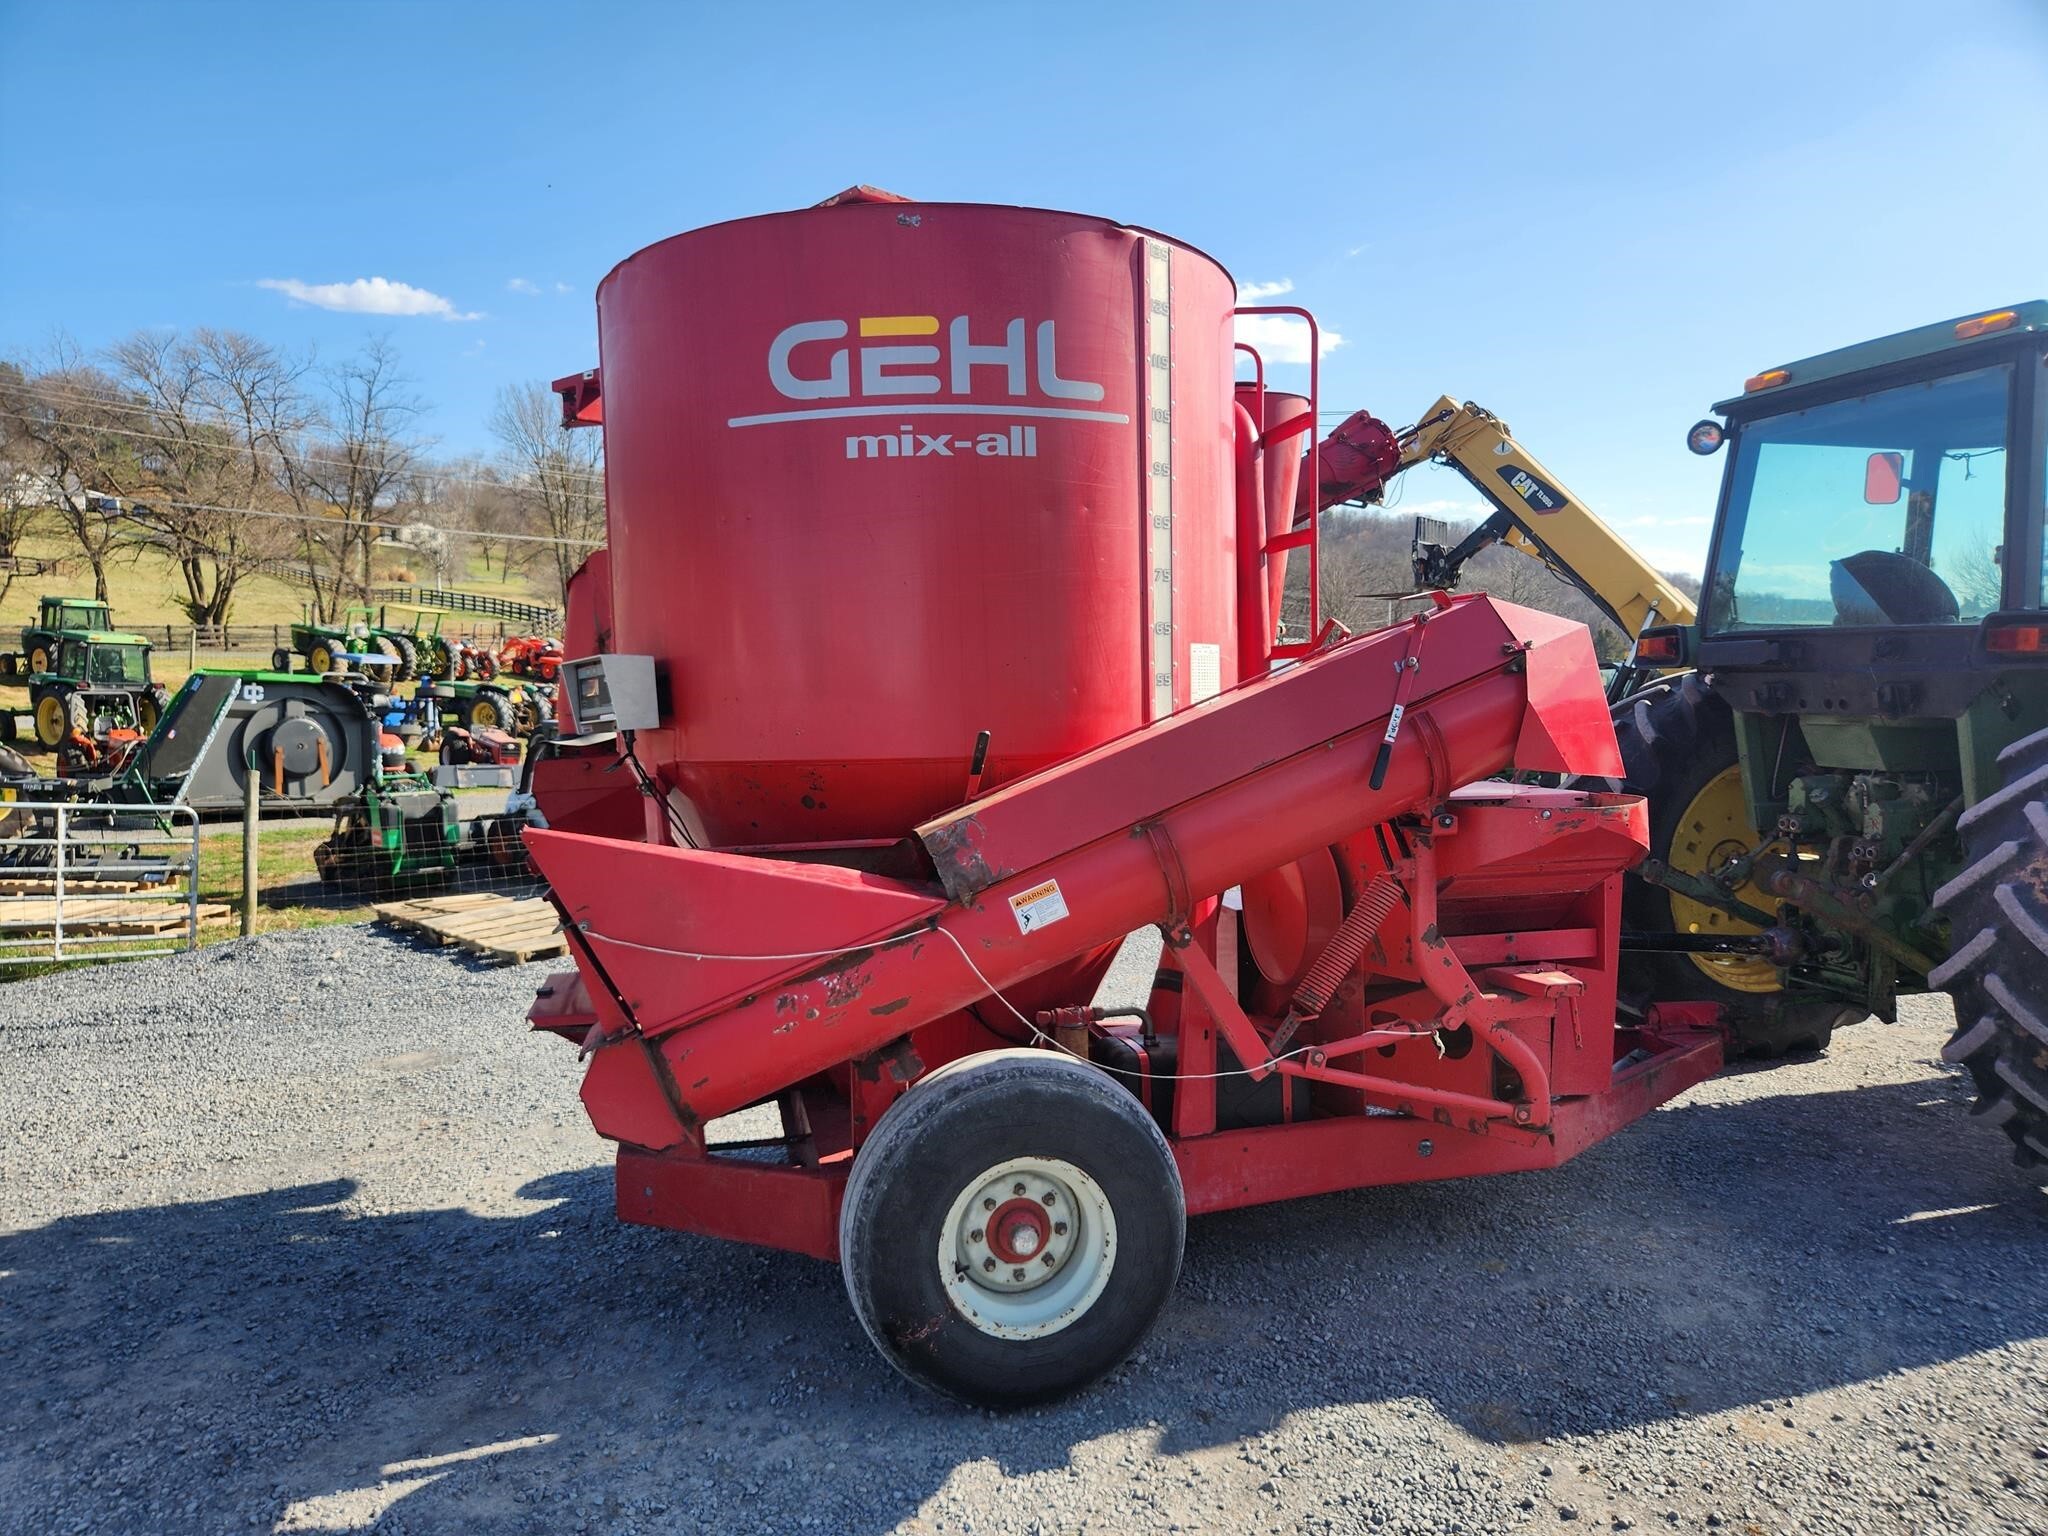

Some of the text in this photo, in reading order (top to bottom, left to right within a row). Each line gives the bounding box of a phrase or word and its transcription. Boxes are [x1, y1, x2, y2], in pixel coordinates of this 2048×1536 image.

[768, 315, 1105, 401] GEHL
[1151, 353, 1169, 369] 115
[1152, 407, 1170, 424] 105
[846, 425, 1037, 459] mix-all
[1153, 461, 1170, 477] 95
[1510, 471, 1540, 499] CAT
[1153, 515, 1171, 529] 85
[1154, 568, 1171, 582] 75
[1155, 622, 1172, 635] 65
[1156, 673, 1172, 687] 55
[1021, 884, 1056, 904] WARNING
